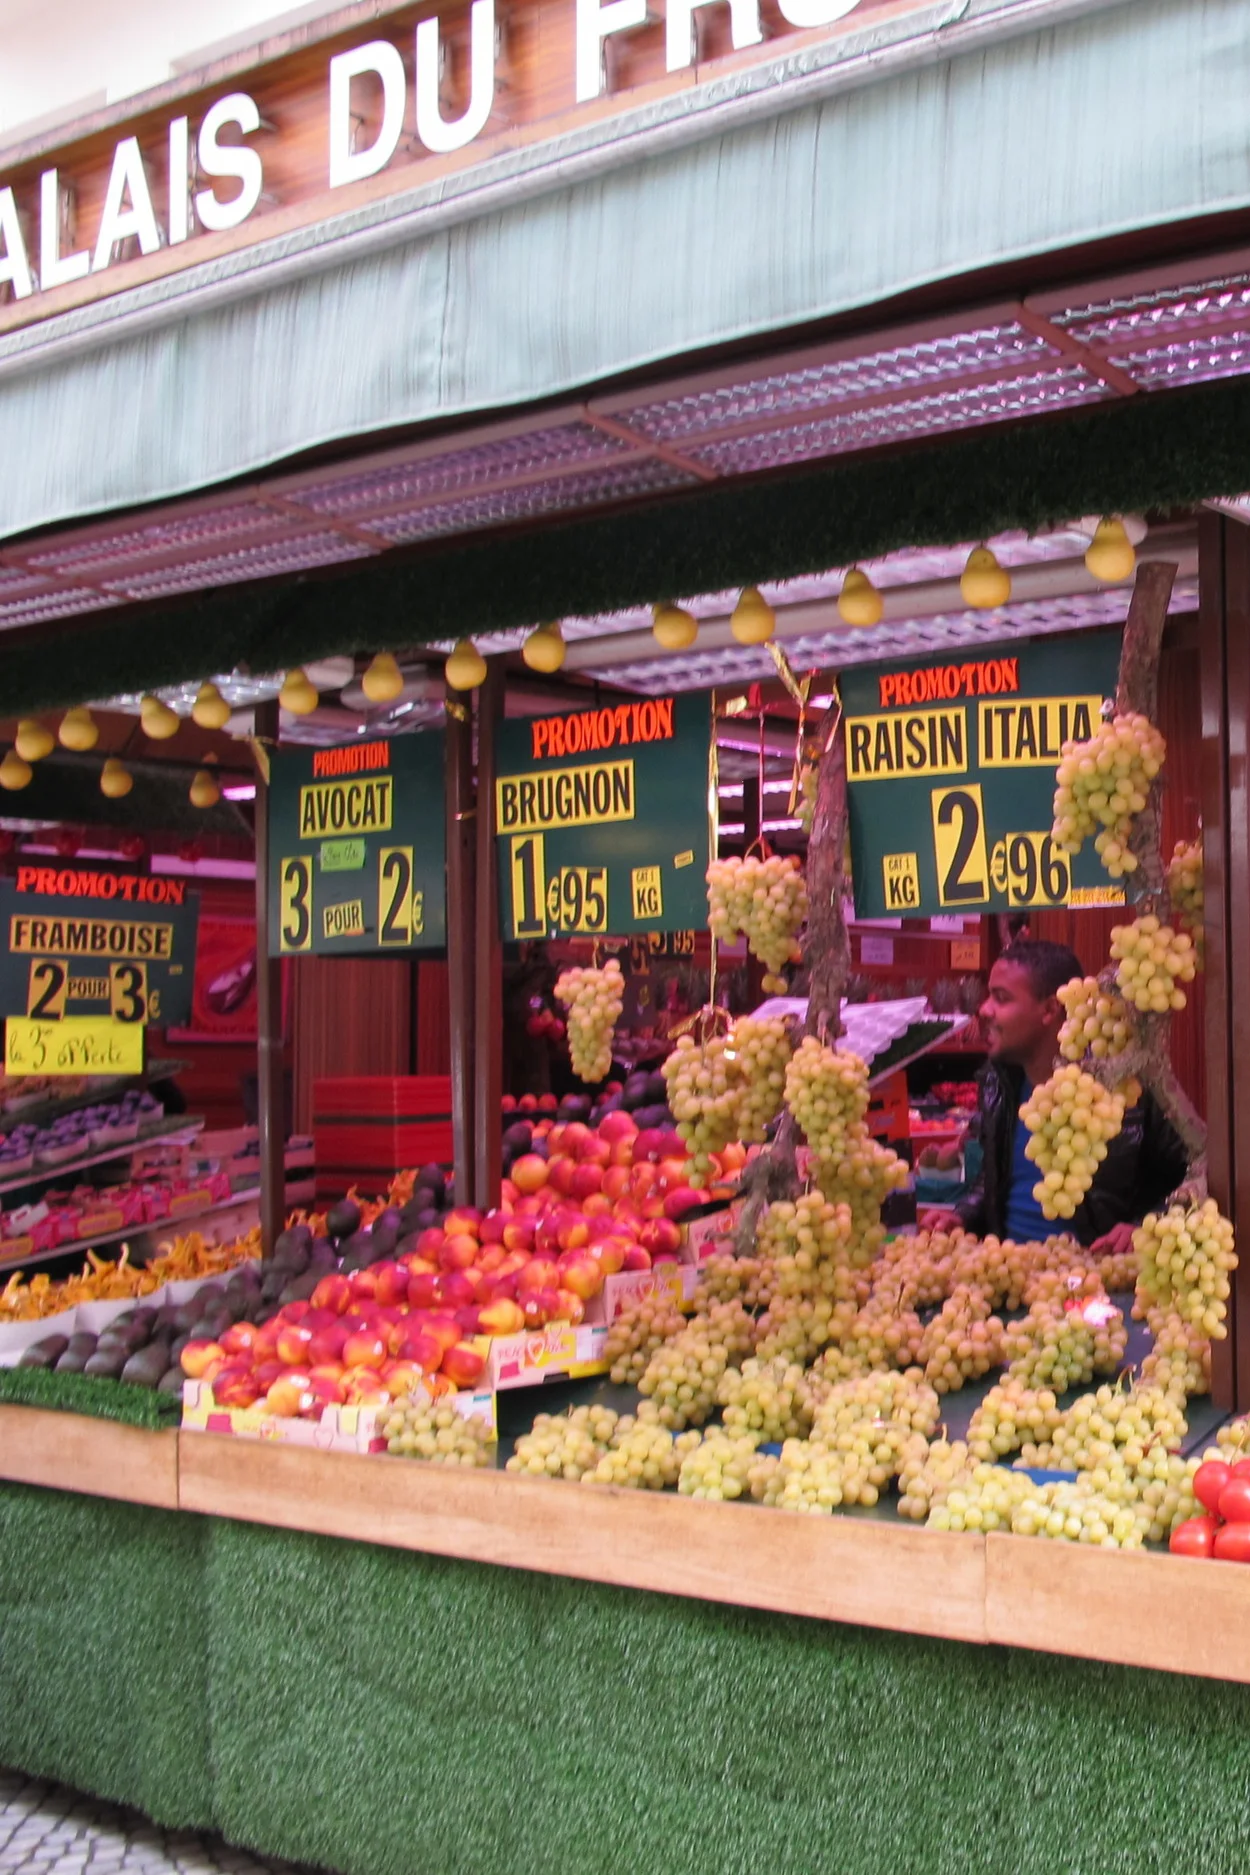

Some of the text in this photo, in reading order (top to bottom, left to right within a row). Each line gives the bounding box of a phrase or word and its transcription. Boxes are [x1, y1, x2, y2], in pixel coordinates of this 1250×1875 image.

[329, 0, 494, 189] DU
[880, 658, 1018, 707] PROMOTION
[532, 698, 674, 759] PROMOTION
[850, 703, 1092, 774] RAISIN ITALIA
[313, 741, 389, 777] PROMOTION
[302, 783, 391, 834] AVOCAT
[501, 765, 631, 826] BRUGNON
[16, 866, 186, 905] PROMOTION
[284, 860, 309, 947] 3
[326, 904, 361, 934] POUR
[637, 886, 659, 915] KG
[889, 875, 916, 905] KG
[15, 919, 169, 956] FRAMBOISE
[30, 962, 65, 1021] 2
[68, 979, 109, 999] POUR
